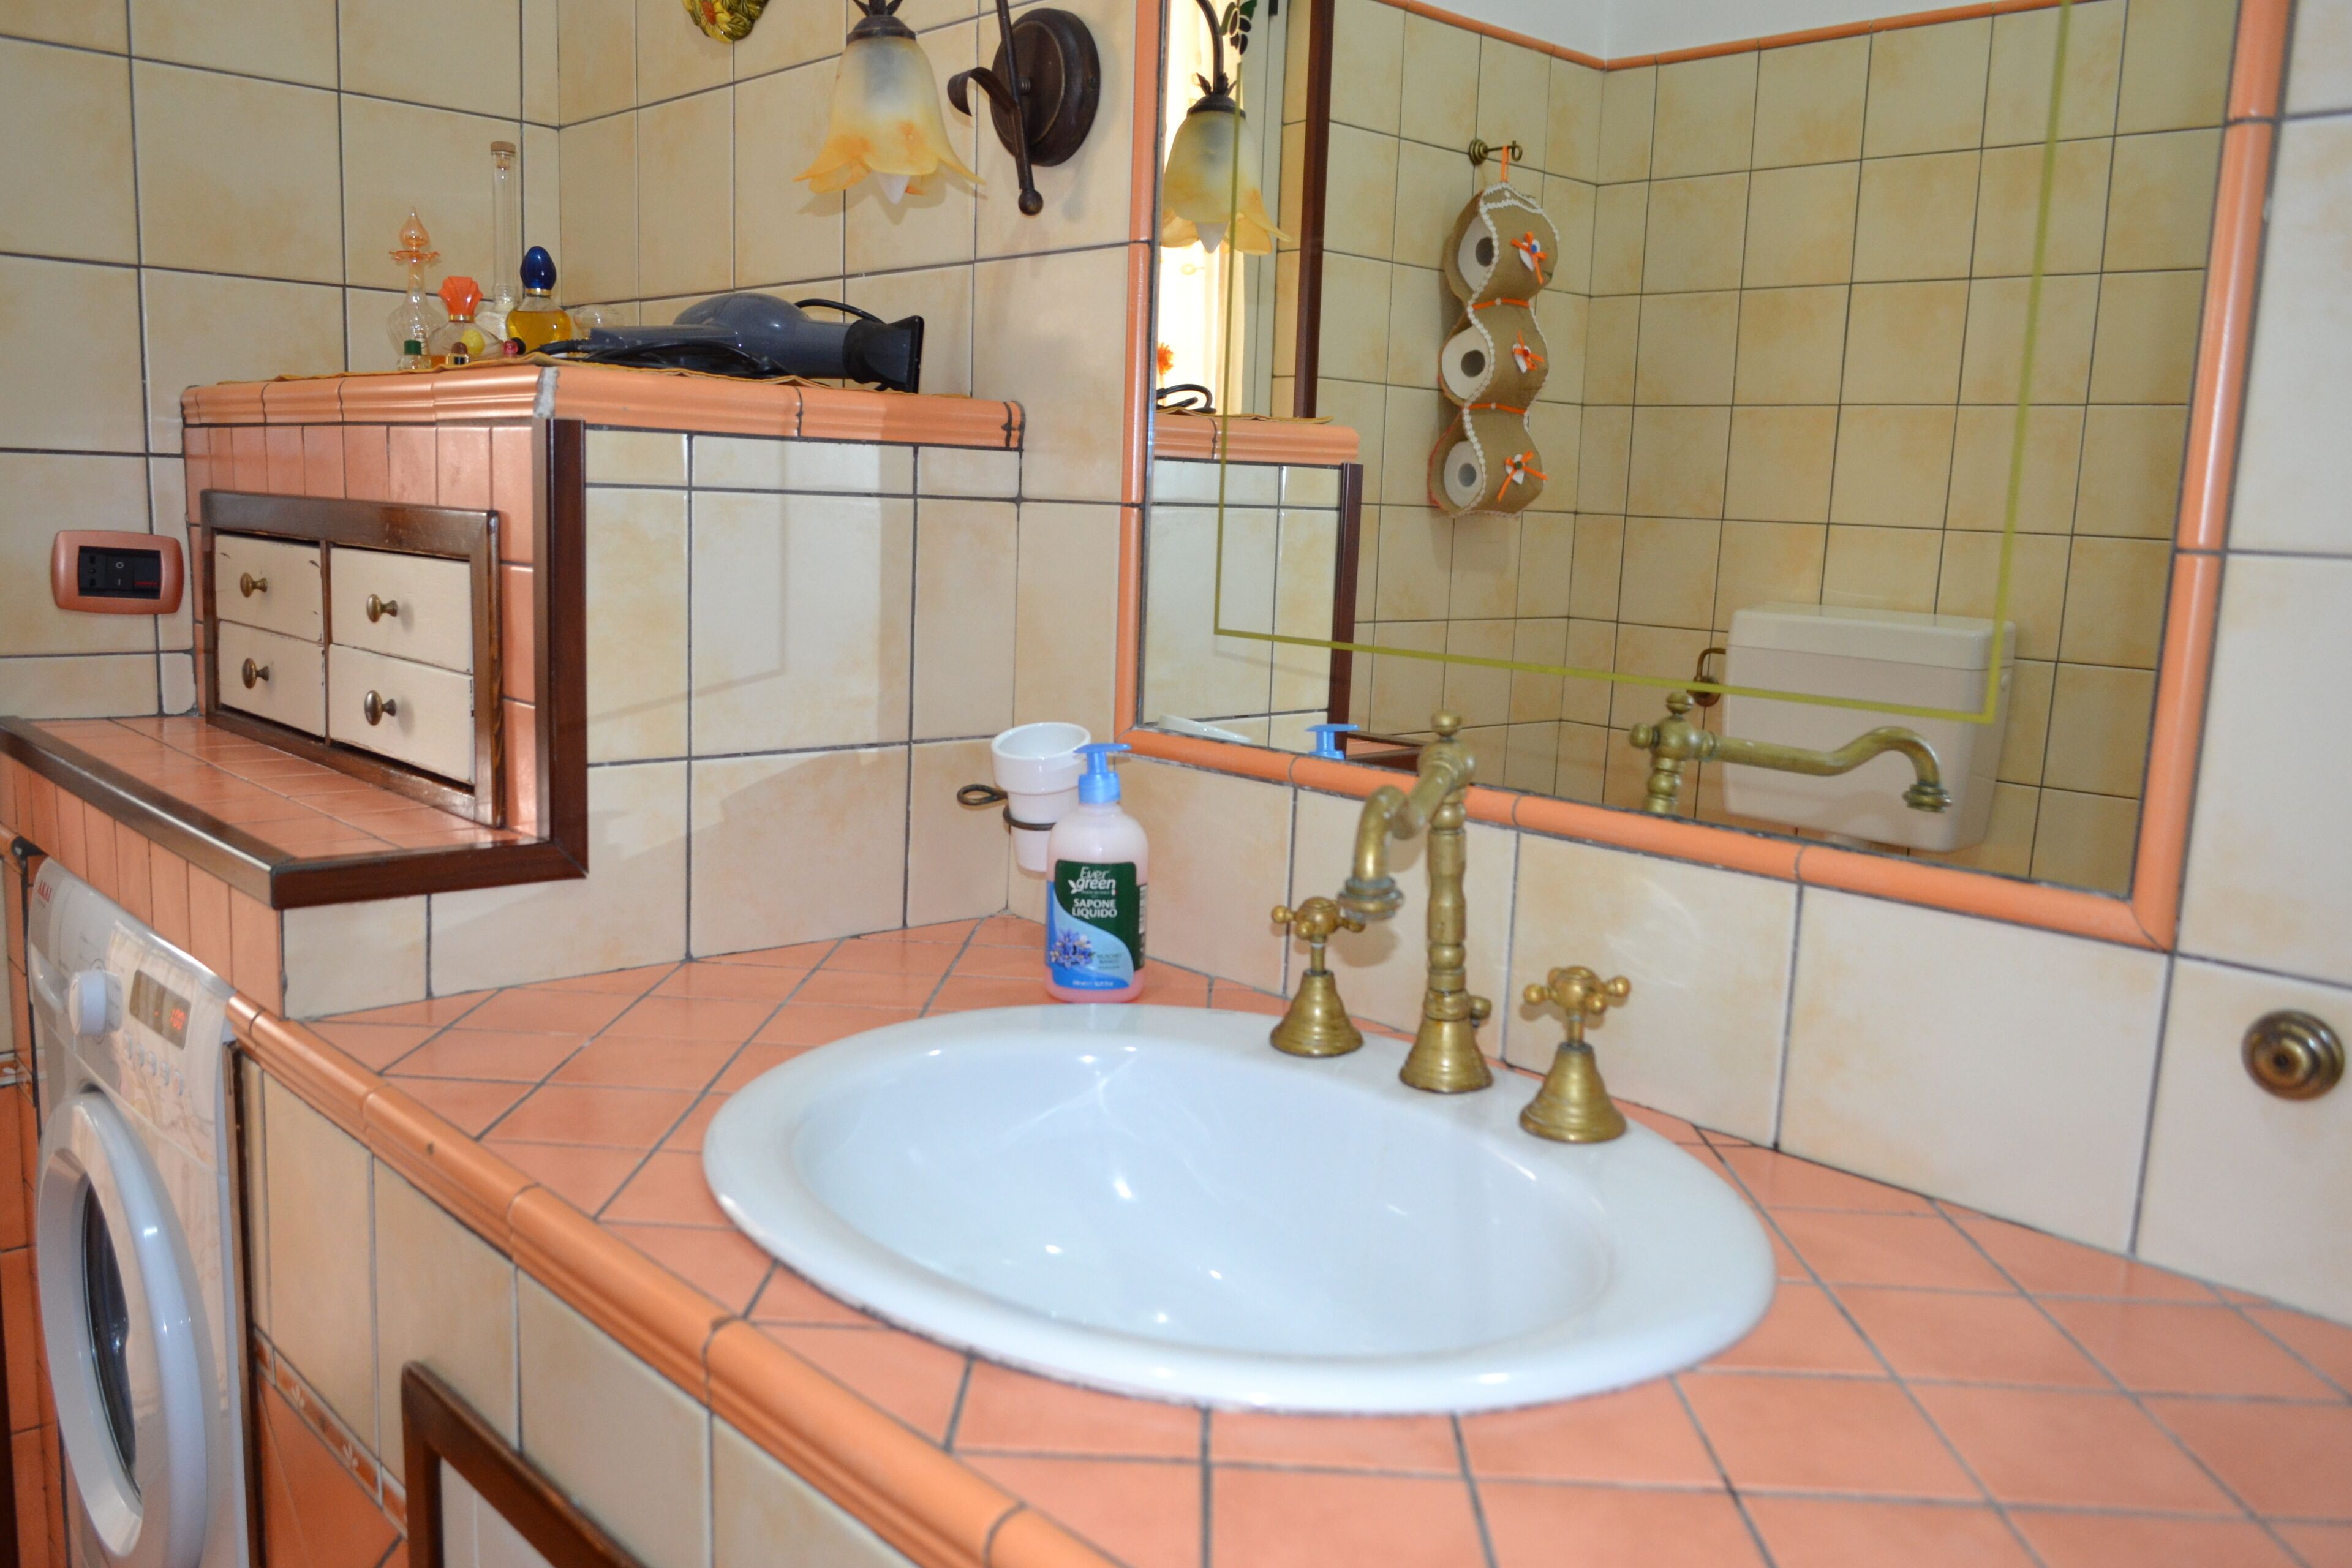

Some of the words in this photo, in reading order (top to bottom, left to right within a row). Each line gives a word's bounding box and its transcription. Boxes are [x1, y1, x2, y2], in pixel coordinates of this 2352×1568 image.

[1080, 867, 1109, 878] Ever
[38, 880, 52, 900] AKAI
[1076, 878, 1116, 892] green
[1073, 899, 1116, 908] SAPONE
[1072, 908, 1117, 919] LIQUIDO
